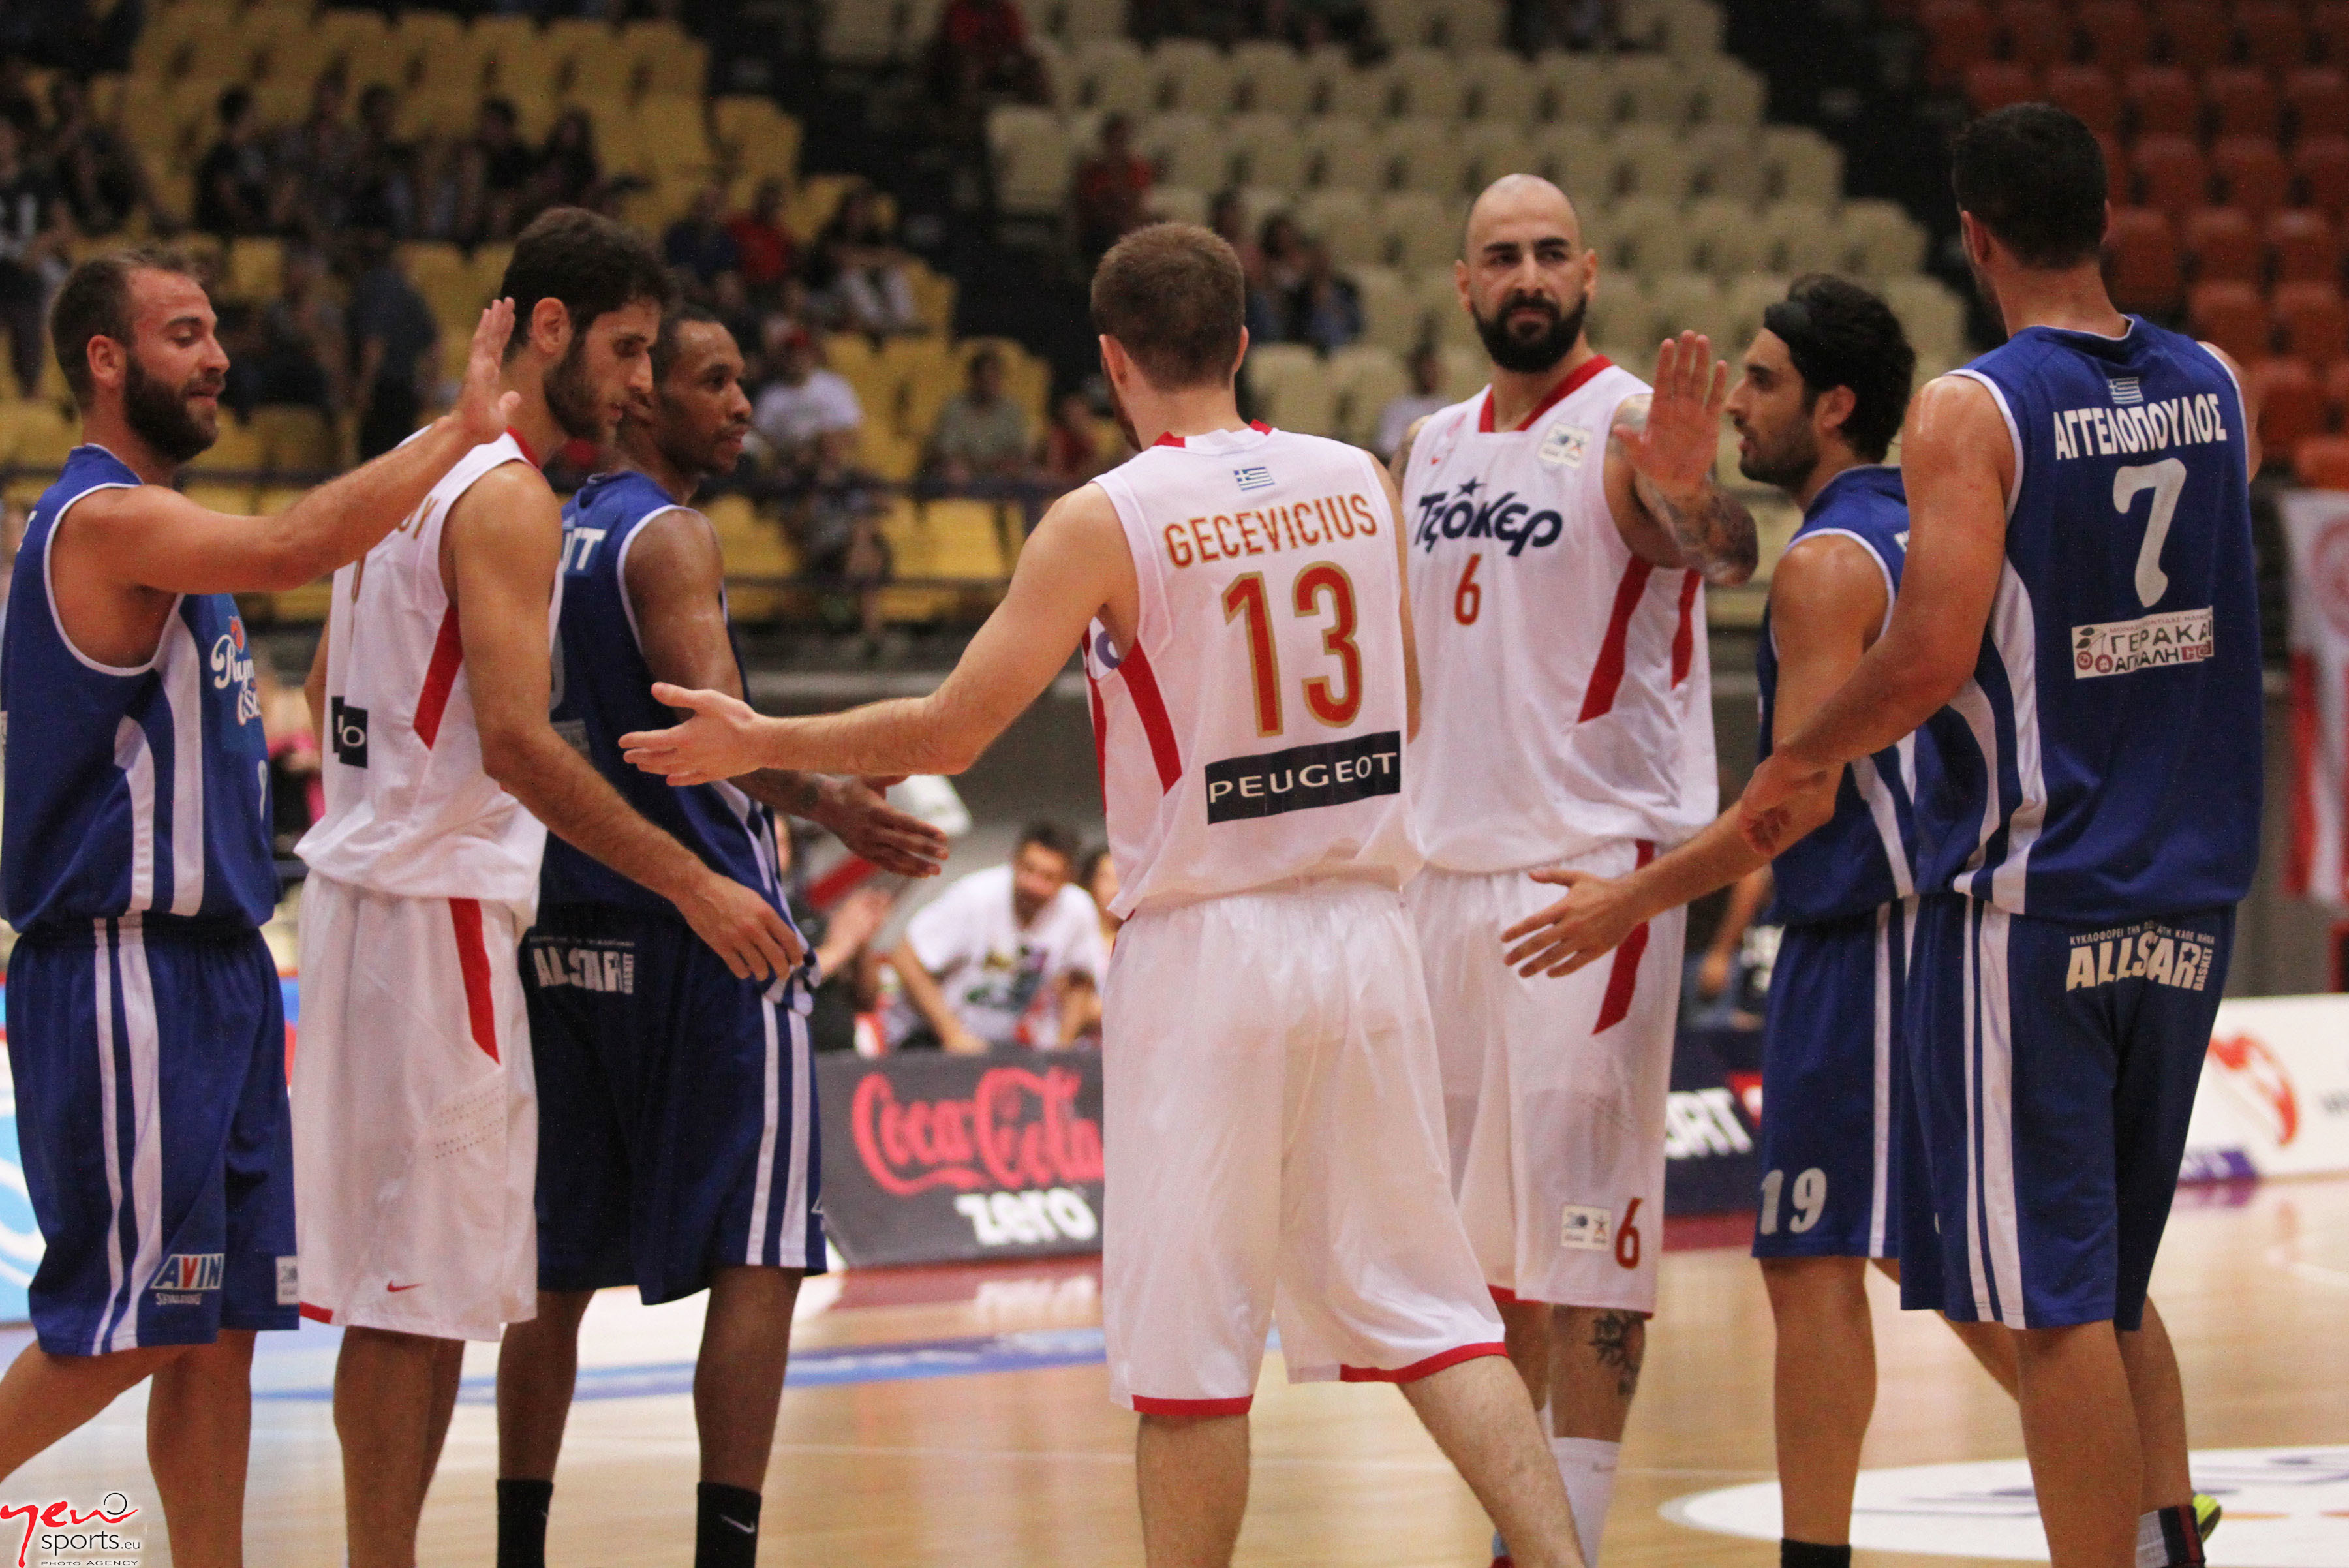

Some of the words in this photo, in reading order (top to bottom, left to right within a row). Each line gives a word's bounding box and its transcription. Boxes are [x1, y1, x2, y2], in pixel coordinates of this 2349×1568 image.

[2053, 393, 2227, 460] ΑΓΓΕΛΟΠΟΥΛΟΣ
[1164, 493, 1377, 568] GECEVICIUS
[2113, 457, 2187, 607] 7
[1455, 553, 1482, 626] 6
[1221, 560, 1363, 738] 13
[1208, 752, 1398, 804] PEUGEOT
[2066, 930, 2202, 992] ALLSAR
[852, 1066, 1104, 1197] Coca-Cola
[954, 1187, 1098, 1246] zero
[1616, 1197, 1644, 1270] 6
[1760, 1168, 1827, 1235] 19
[154, 1255, 223, 1290] AVIN
